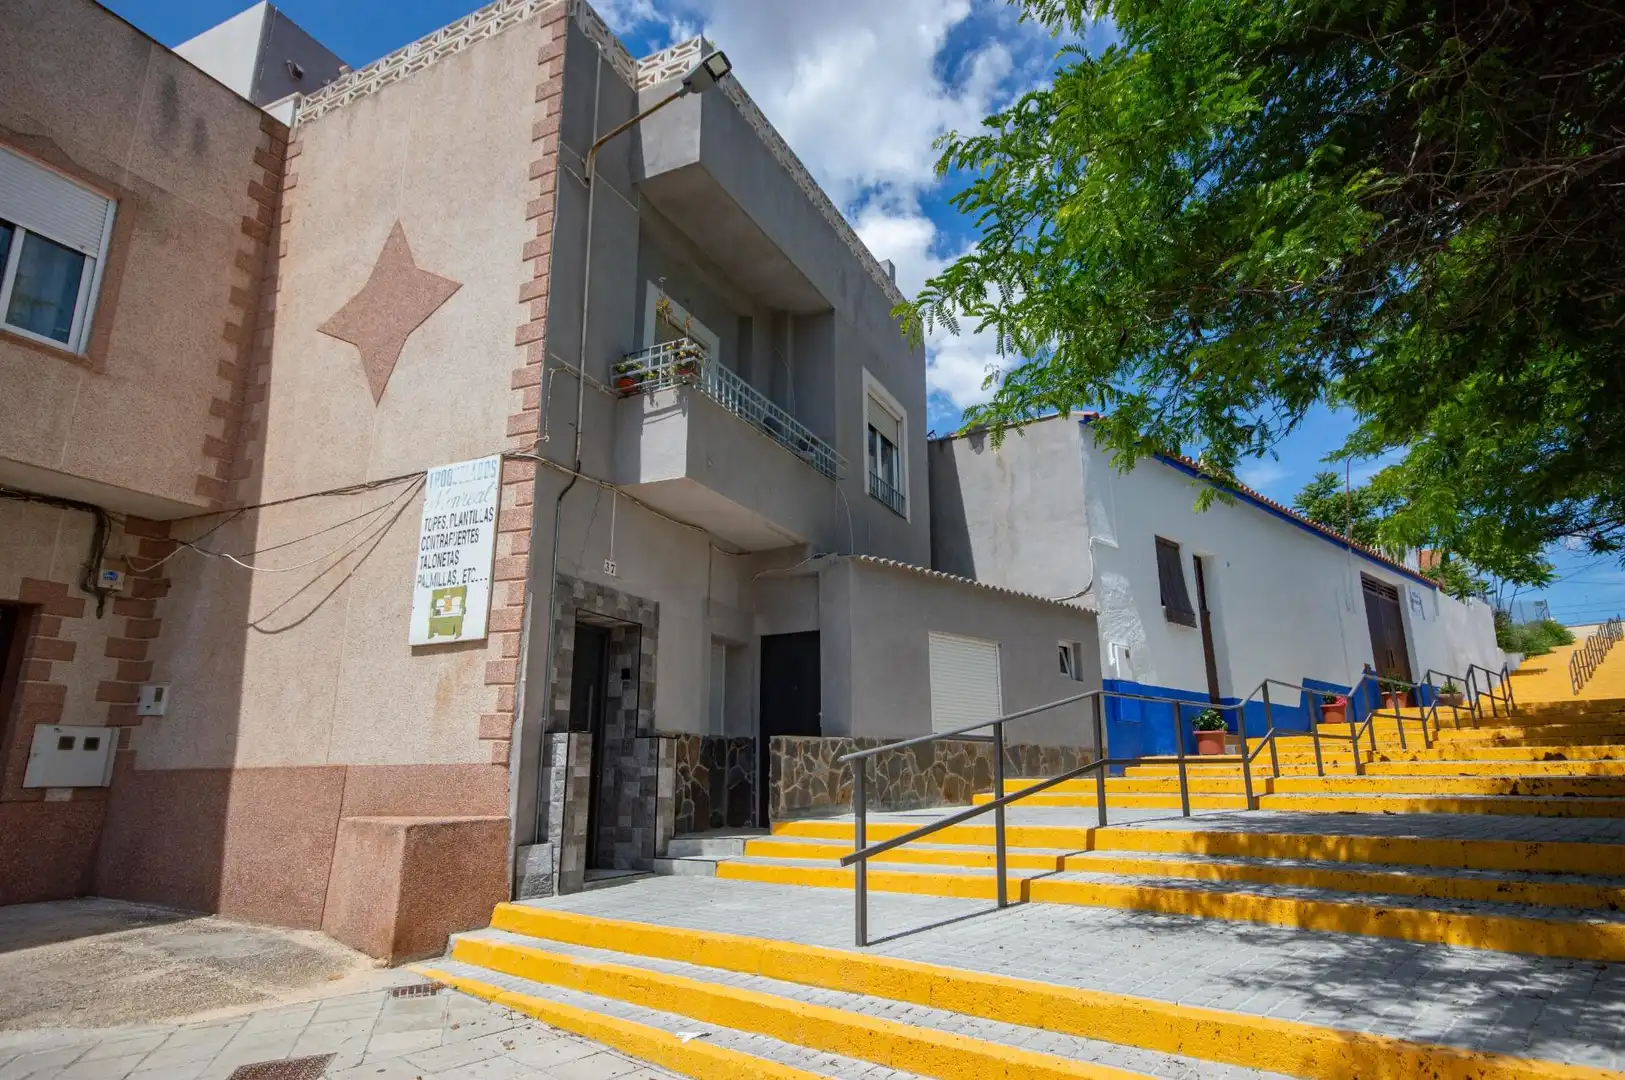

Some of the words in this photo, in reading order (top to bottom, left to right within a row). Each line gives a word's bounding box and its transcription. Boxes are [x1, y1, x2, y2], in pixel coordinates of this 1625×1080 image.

[421, 528, 480, 551] CONTRAFUERTES
[420, 549, 460, 570] TALONETAS
[605, 561, 616, 574] 37
